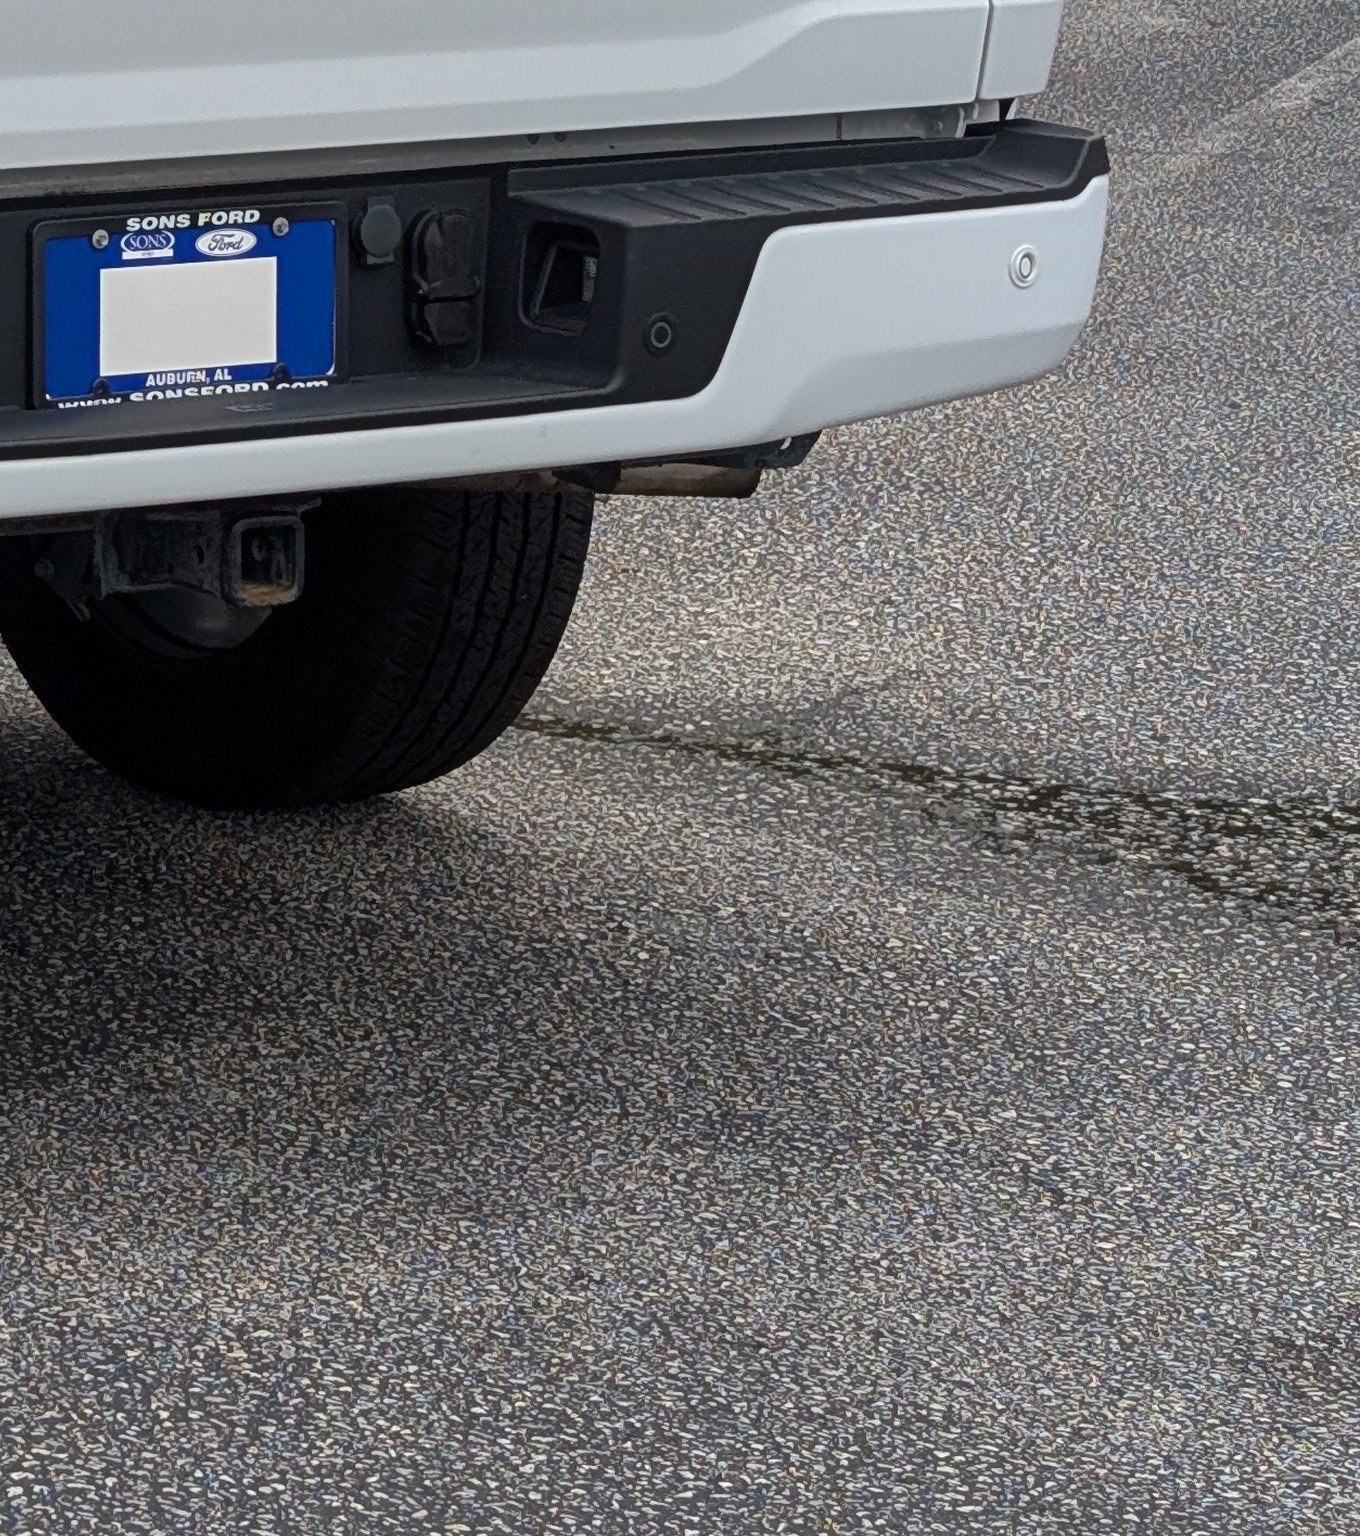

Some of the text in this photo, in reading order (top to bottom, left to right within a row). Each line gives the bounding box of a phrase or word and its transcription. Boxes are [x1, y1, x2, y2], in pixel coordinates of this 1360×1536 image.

[125, 209, 261, 232] SONS FORD
[129, 233, 167, 250] SONS
[207, 232, 245, 252] Ford
[213, 367, 233, 382] AL
